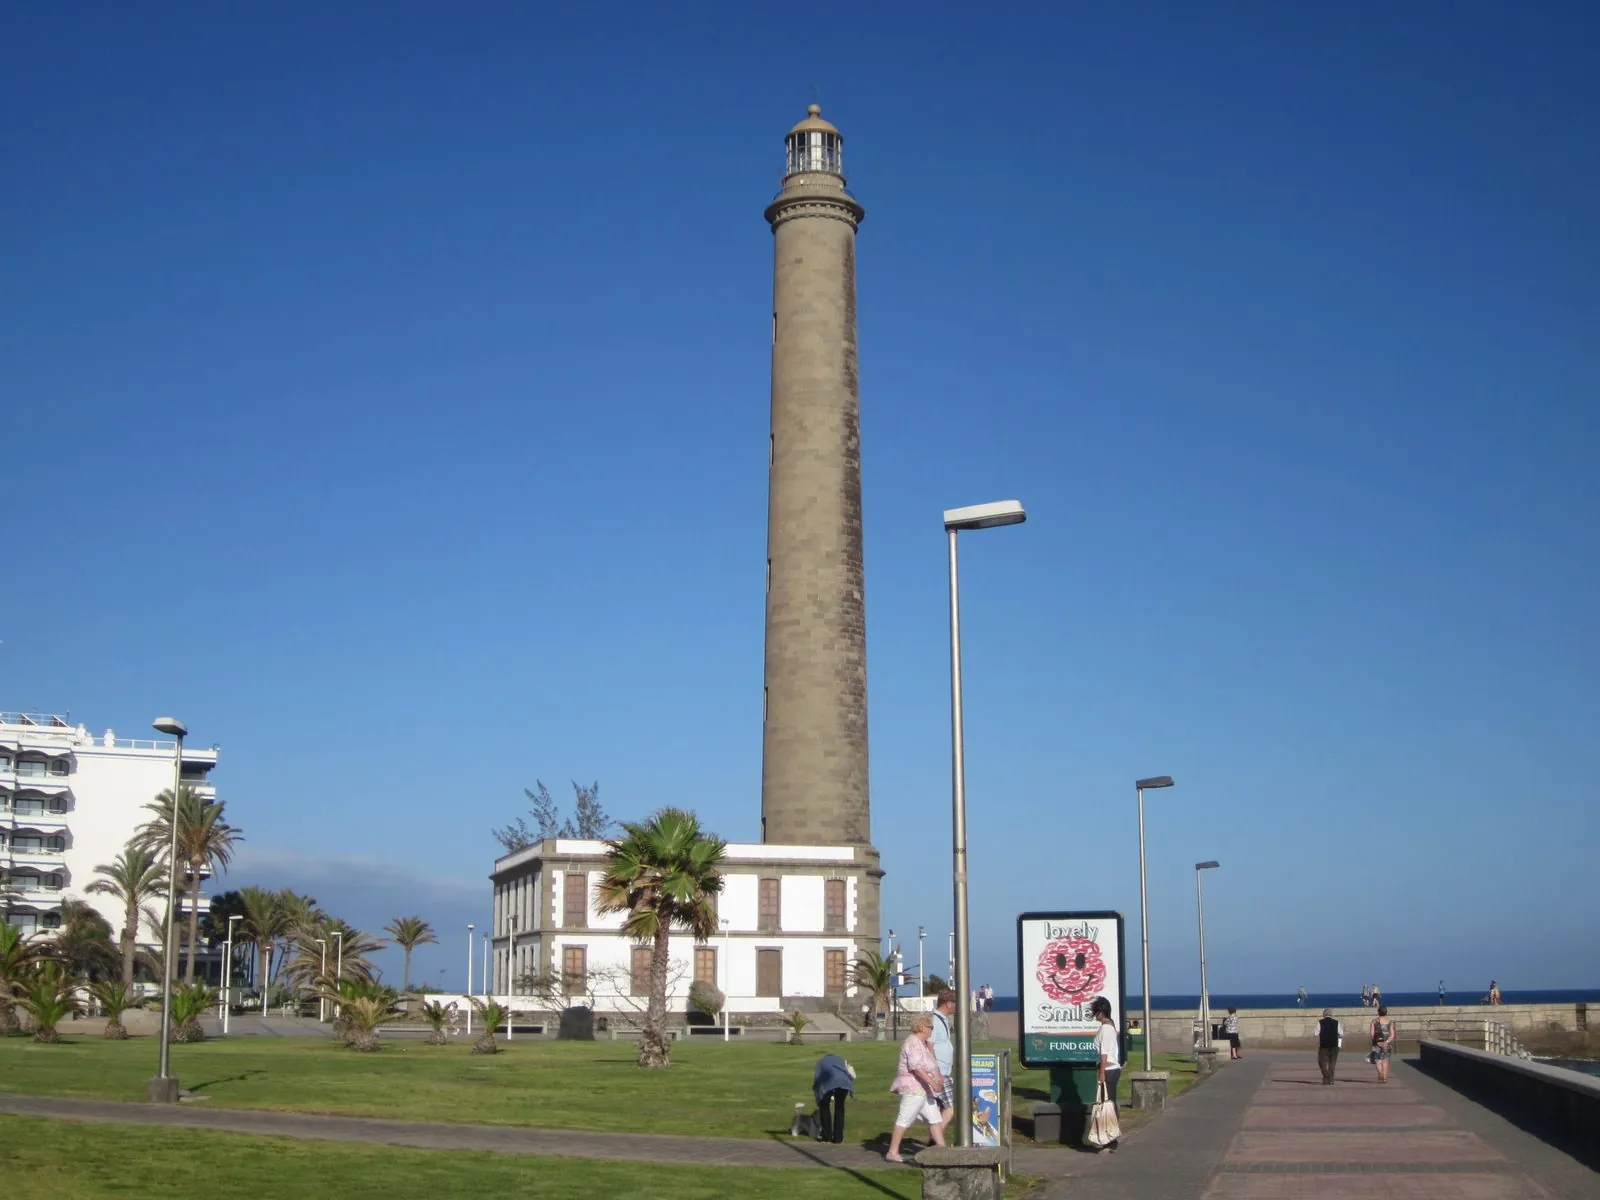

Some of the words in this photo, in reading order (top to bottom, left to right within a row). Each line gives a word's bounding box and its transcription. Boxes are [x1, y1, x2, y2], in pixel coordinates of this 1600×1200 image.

[1044, 921, 1098, 942] lovely
[1038, 1003, 1095, 1022] Smile
[1050, 1042, 1077, 1051] FUND
